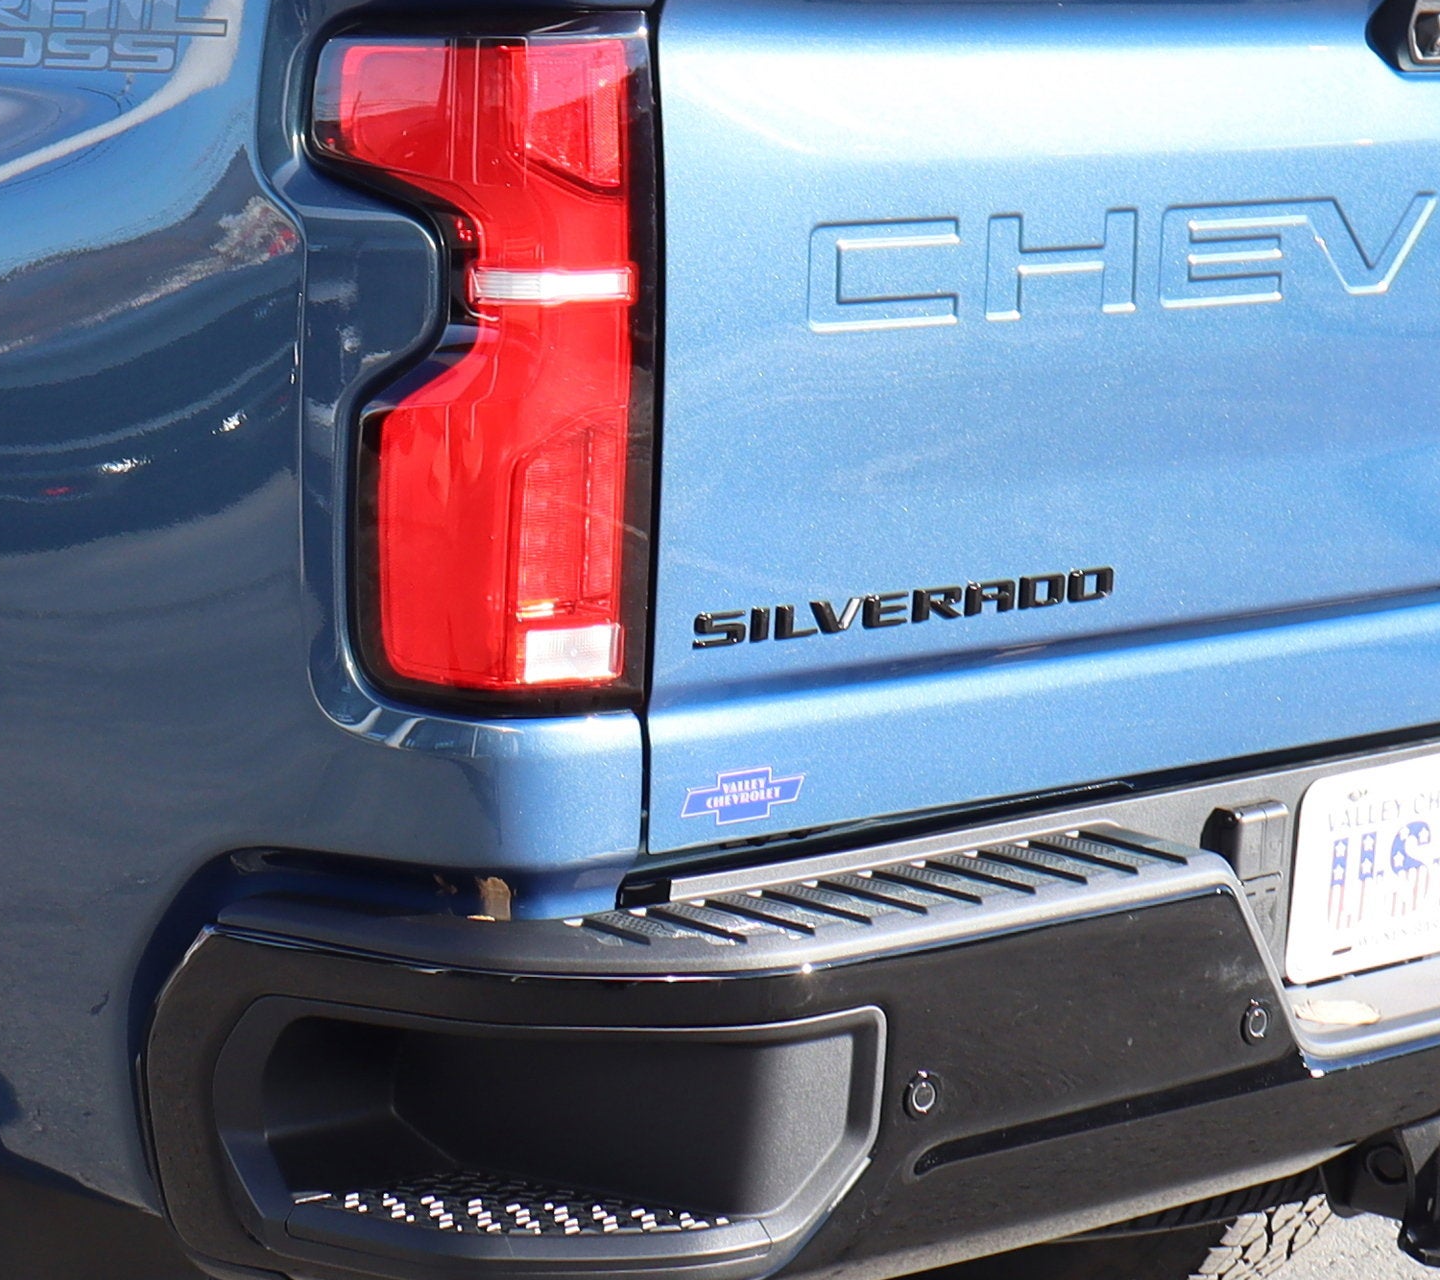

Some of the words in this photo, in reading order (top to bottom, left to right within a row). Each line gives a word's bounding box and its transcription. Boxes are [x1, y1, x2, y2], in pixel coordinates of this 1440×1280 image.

[691, 565, 1115, 650] SILVERADO
[705, 786, 781, 809] CHEVROLET
[722, 776, 767, 794] VALLEY
[1328, 798, 1402, 832] VALLEY
